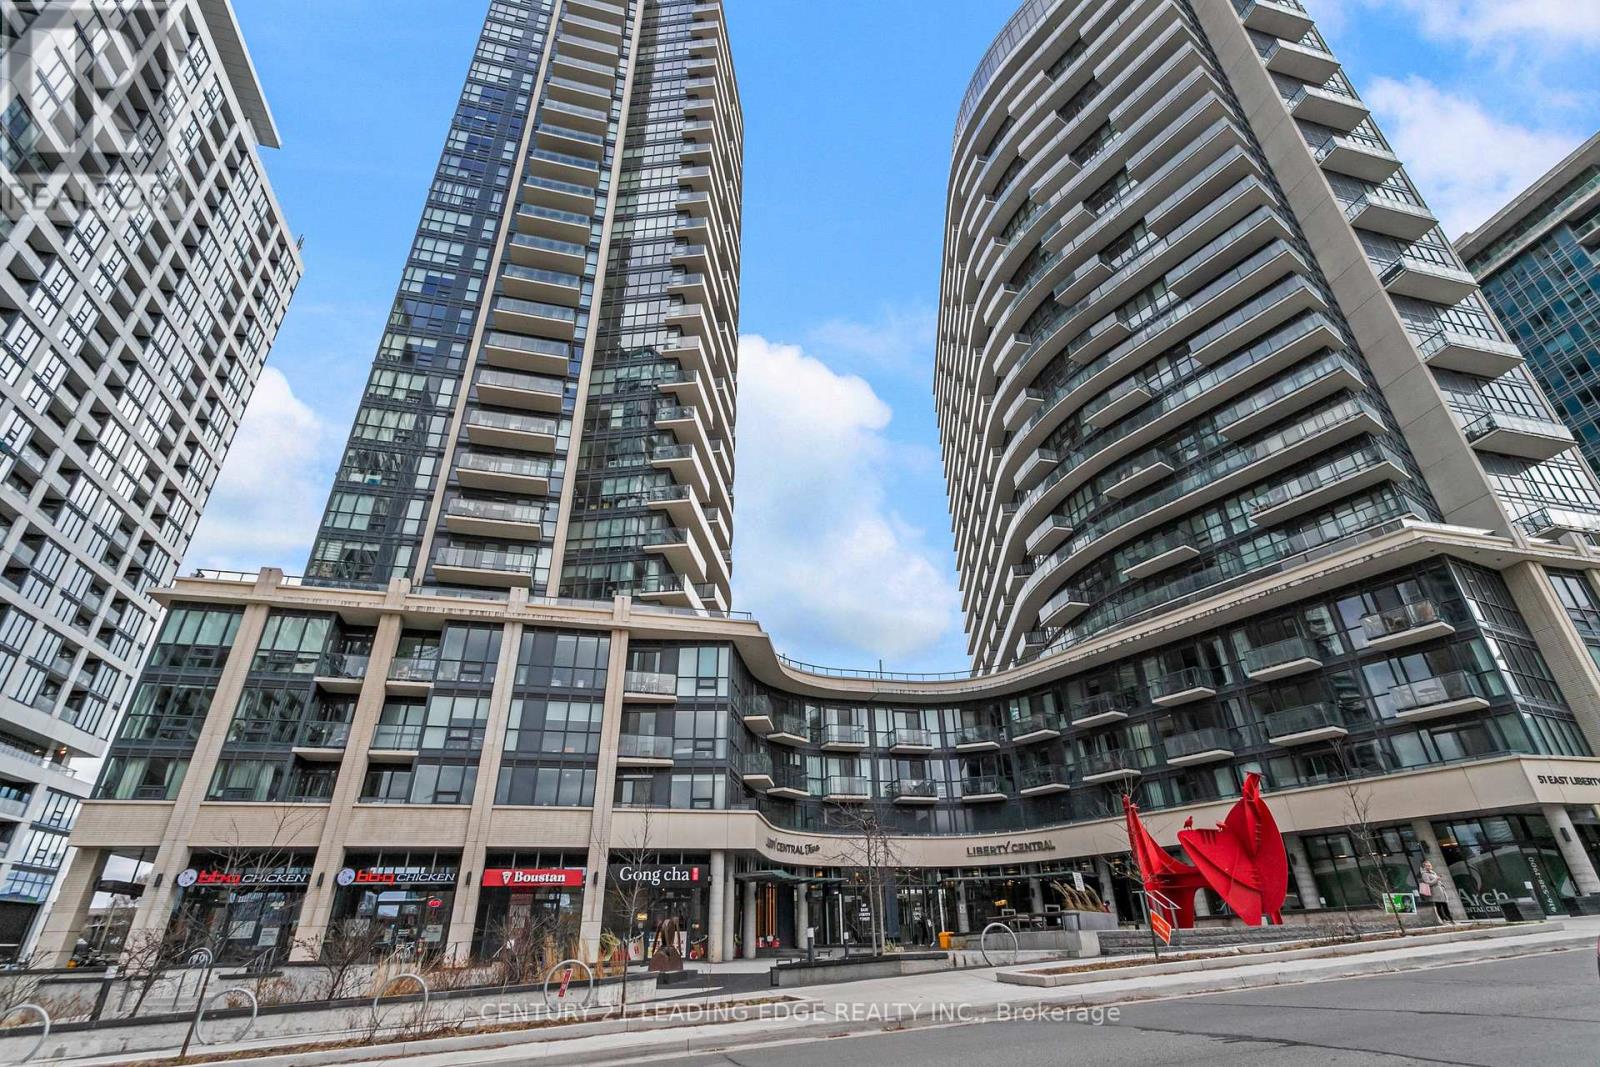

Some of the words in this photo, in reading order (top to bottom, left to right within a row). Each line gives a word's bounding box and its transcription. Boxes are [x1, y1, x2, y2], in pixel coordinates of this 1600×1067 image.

[1547, 776, 1568, 784] EAST
[777, 842, 804, 855] CENTRAL
[966, 841, 1010, 856] LIBERTY
[1012, 840, 1055, 853] CENTRAL
[242, 874, 306, 883] CHICKEN
[396, 873, 455, 881] CHICKEN
[514, 871, 565, 882] Boustan
[619, 866, 661, 886] Gong
[663, 866, 689, 881] cha
[1458, 888, 1508, 906] Arch
